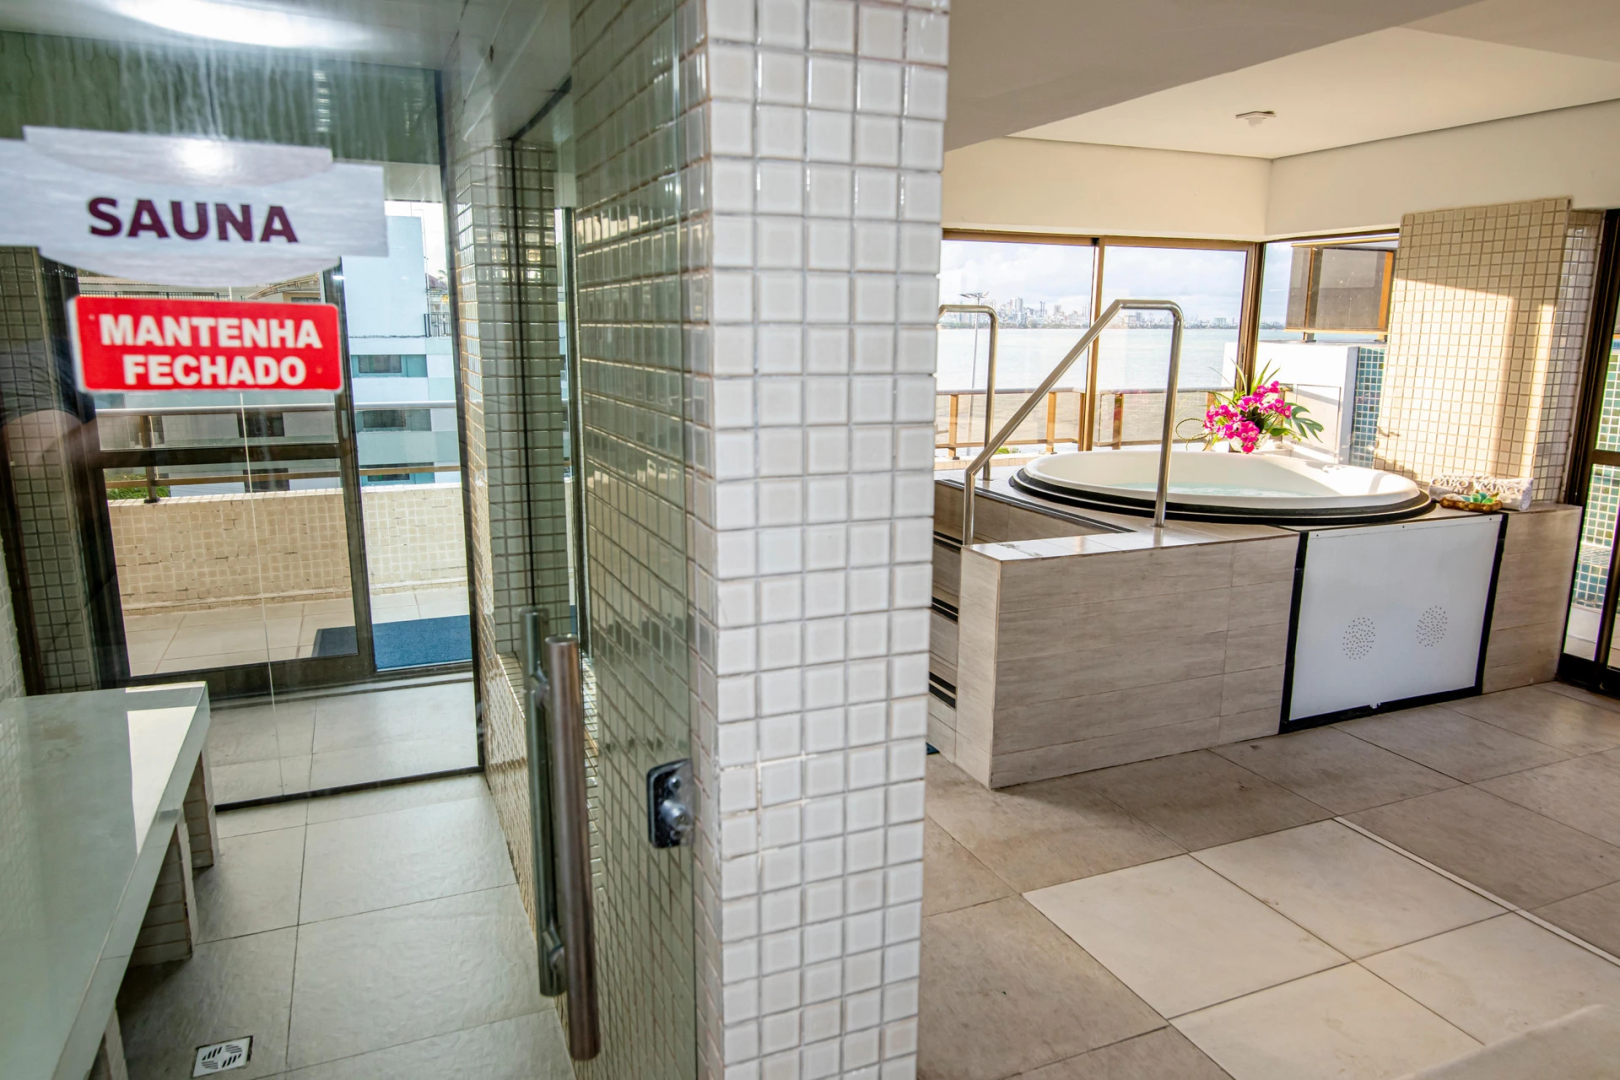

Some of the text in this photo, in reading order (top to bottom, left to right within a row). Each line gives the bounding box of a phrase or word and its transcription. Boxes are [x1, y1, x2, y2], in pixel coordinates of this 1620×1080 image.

[87, 196, 298, 243] SAUNA
[99, 314, 323, 349] MANTENHA
[123, 355, 307, 385] FECHADO
